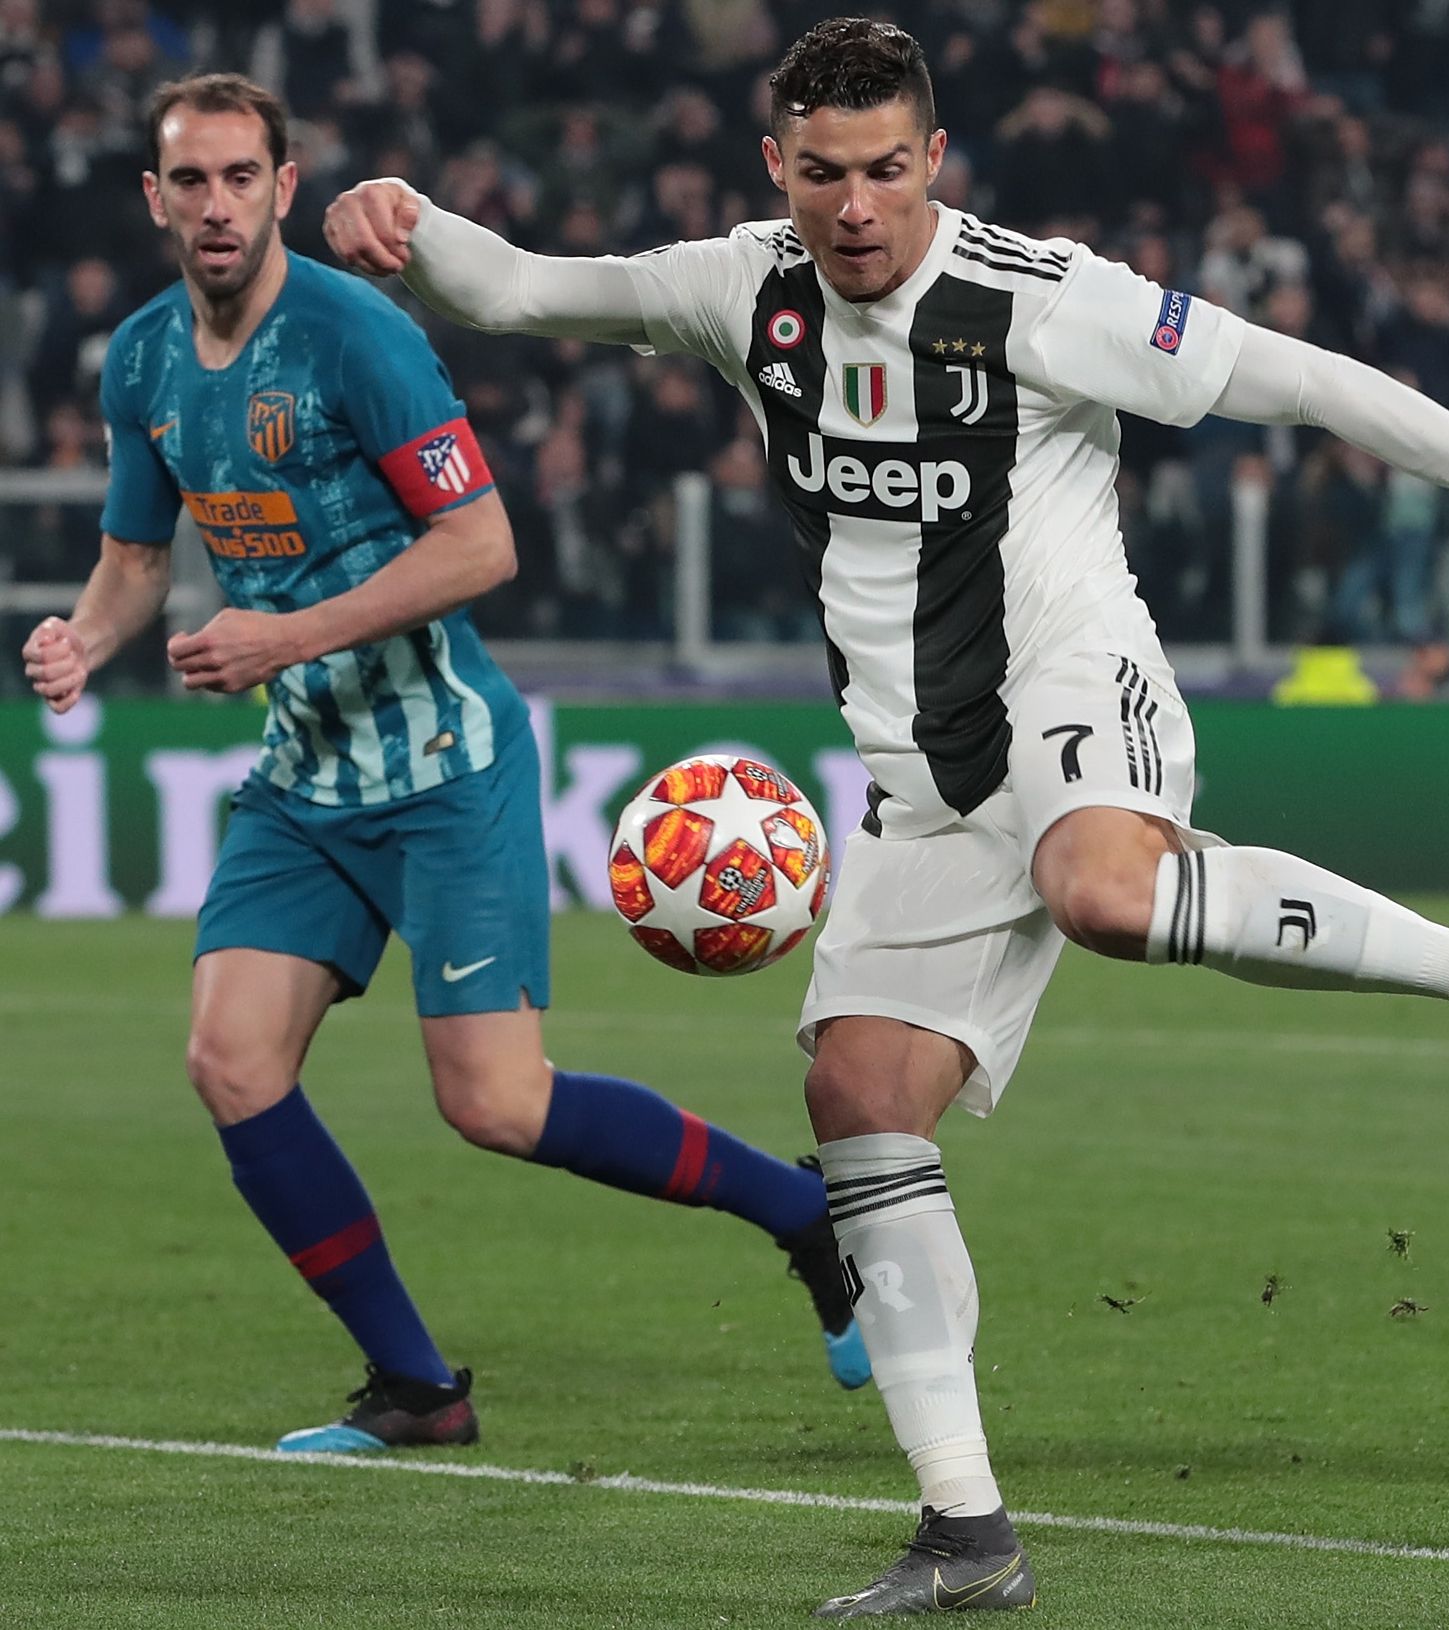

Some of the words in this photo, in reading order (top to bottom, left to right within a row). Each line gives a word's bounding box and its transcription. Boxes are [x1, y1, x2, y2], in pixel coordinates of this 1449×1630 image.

[758, 372, 802, 397] adidas
[787, 431, 971, 522] Jeep
[196, 496, 264, 521] Trade
[1041, 724, 1094, 783] 7
